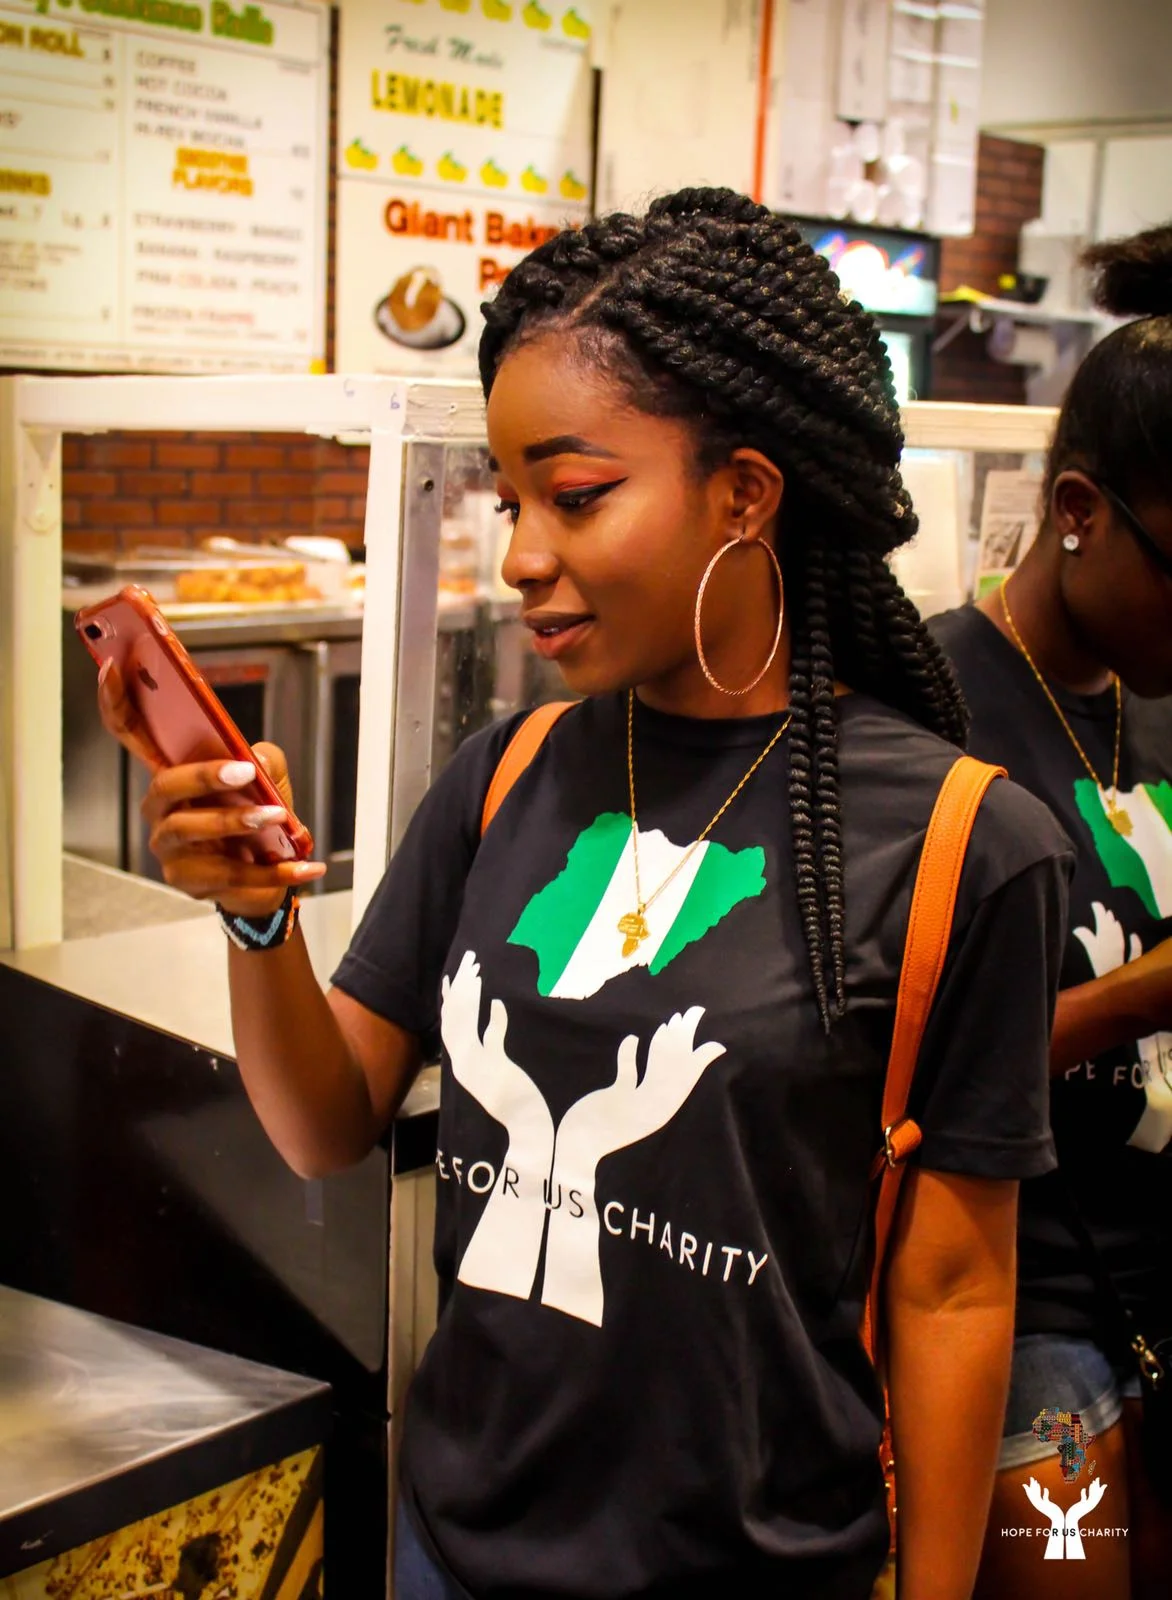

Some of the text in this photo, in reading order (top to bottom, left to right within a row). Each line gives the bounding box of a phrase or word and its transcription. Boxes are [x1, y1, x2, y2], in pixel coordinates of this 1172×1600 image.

[136, 50, 196, 73] COFFEE
[135, 98, 198, 120] FRENCH
[371, 67, 505, 131] LEMONADE
[172, 170, 254, 197] FLAVORS
[384, 197, 473, 245] Giant
[452, 1156, 520, 1199] FOR
[543, 1178, 584, 1218] US
[603, 1201, 768, 1285] CHARITY
